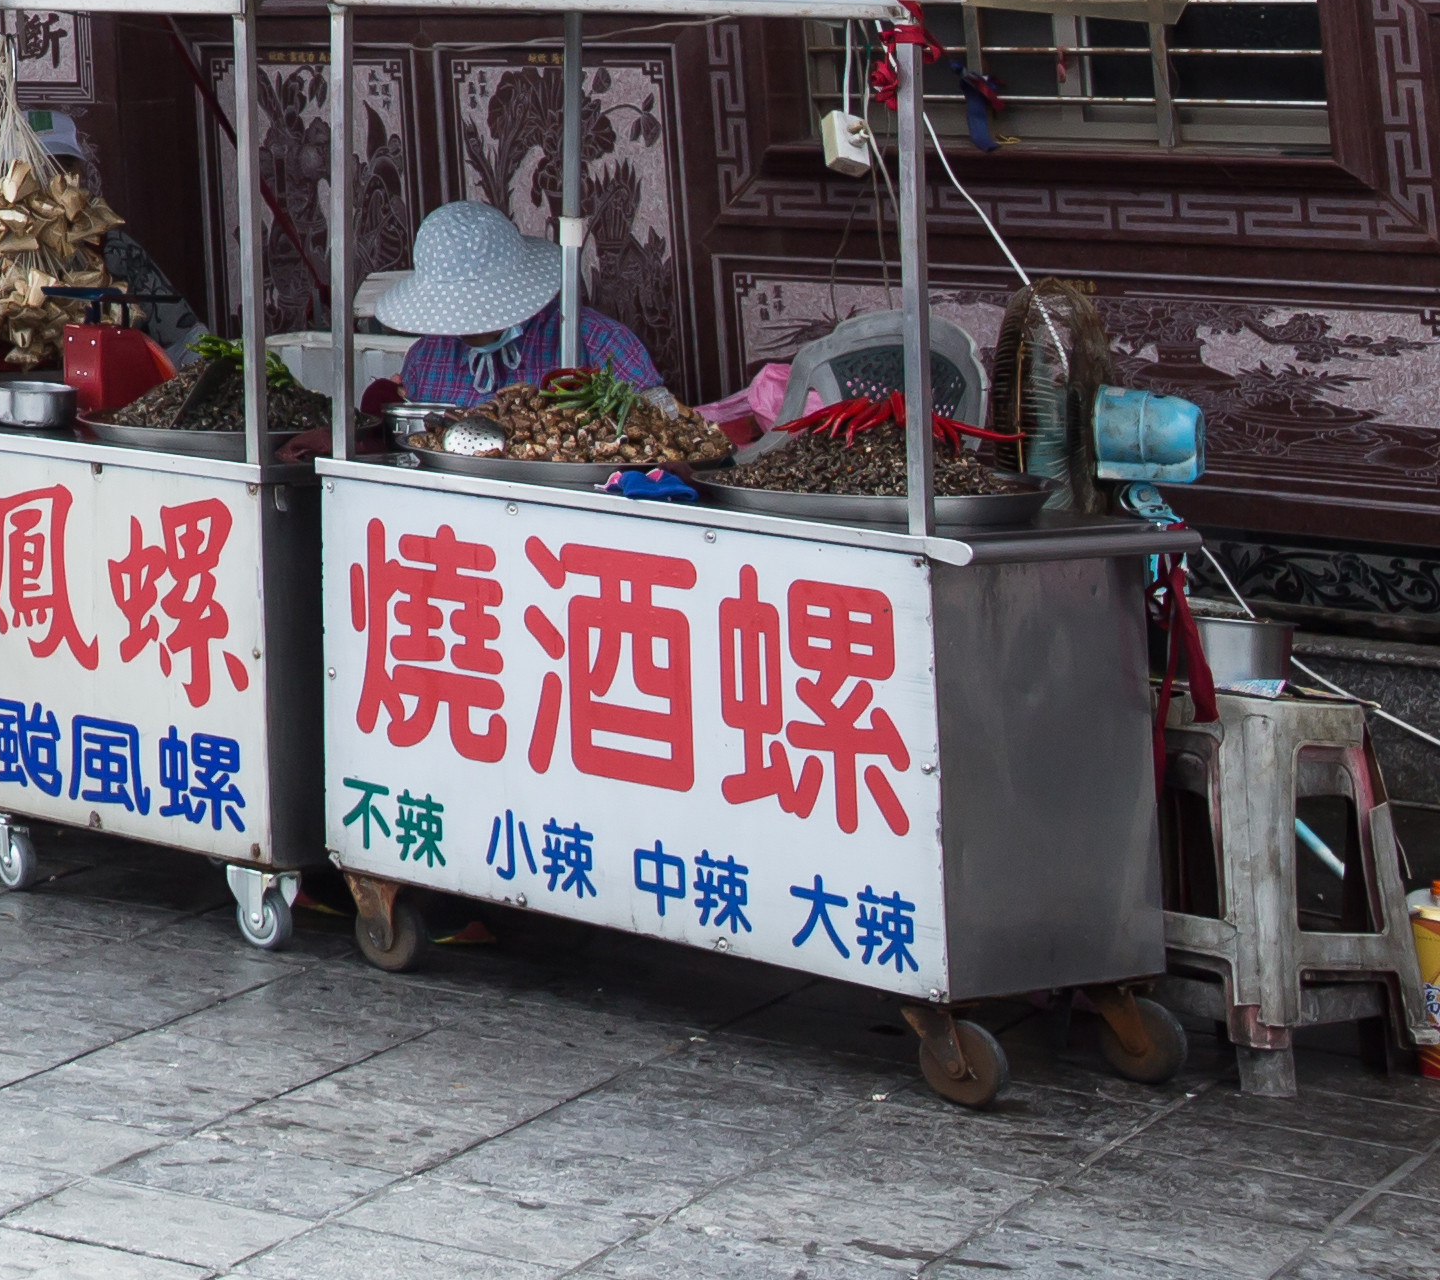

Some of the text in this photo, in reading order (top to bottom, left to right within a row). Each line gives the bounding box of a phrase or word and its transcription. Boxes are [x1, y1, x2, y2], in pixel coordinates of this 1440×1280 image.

[351, 516, 911, 838] 燒酒螺
[342, 776, 922, 976] 不辣 小辣 中辣 大辣
